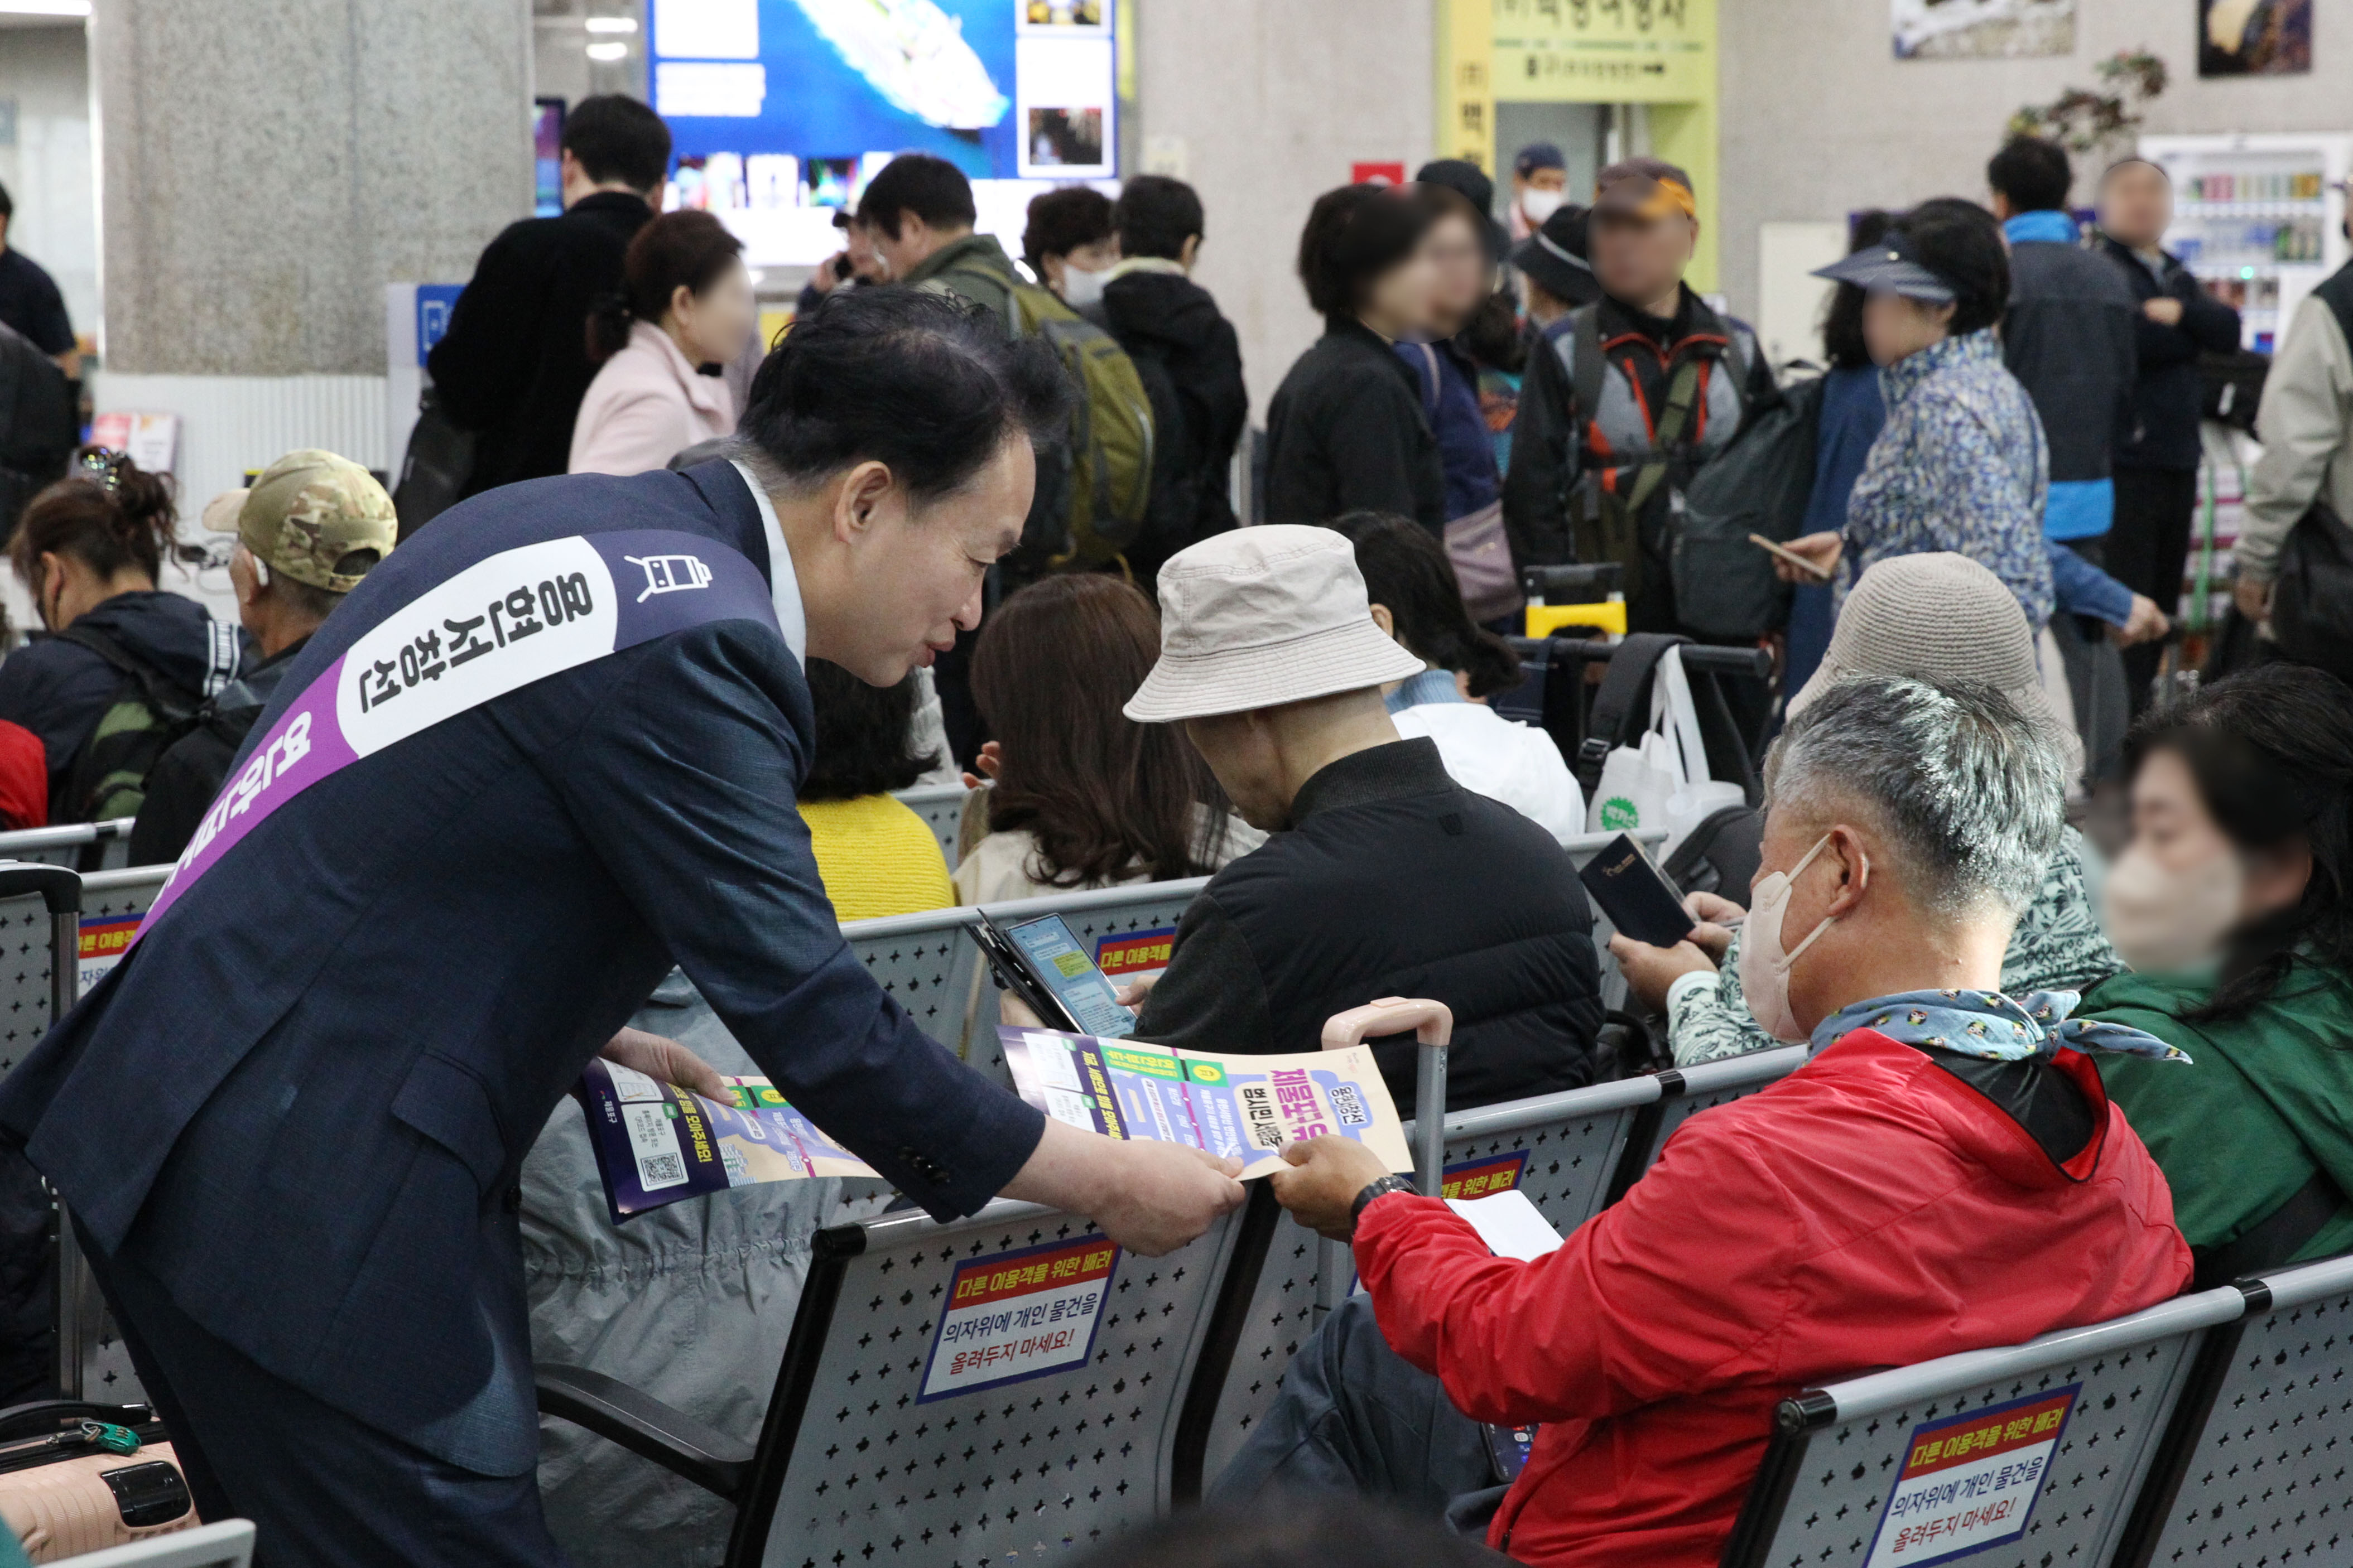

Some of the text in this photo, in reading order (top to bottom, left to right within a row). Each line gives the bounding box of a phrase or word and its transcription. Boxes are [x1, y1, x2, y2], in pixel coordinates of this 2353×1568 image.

[358, 570, 593, 713] 용현서창선
[1100, 952, 1125, 969] 다른
[1126, 943, 1172, 965] 이용객을
[679, 1099, 697, 1114] 힘을
[1243, 1088, 1274, 1120] 범시민
[1270, 1068, 1324, 1125] 제물포구
[685, 1115, 714, 1162] 모아주세요!
[1101, 1109, 1124, 1140] 모아주세
[1462, 1175, 1489, 1195] 위한
[1487, 1169, 1516, 1190] 배려
[956, 1250, 1114, 1299] 다른 이용객을 위한 배려
[943, 1292, 1098, 1343] 의자위에 개인 물건을
[950, 1328, 1075, 1376] 올려두지 마세요!
[1909, 1407, 2065, 1468] 다른 이용객을 위한 배려
[1890, 1456, 2044, 1518] 의자위에 개인 물건을
[1892, 1497, 2017, 1553] 올려두지 마세요!
